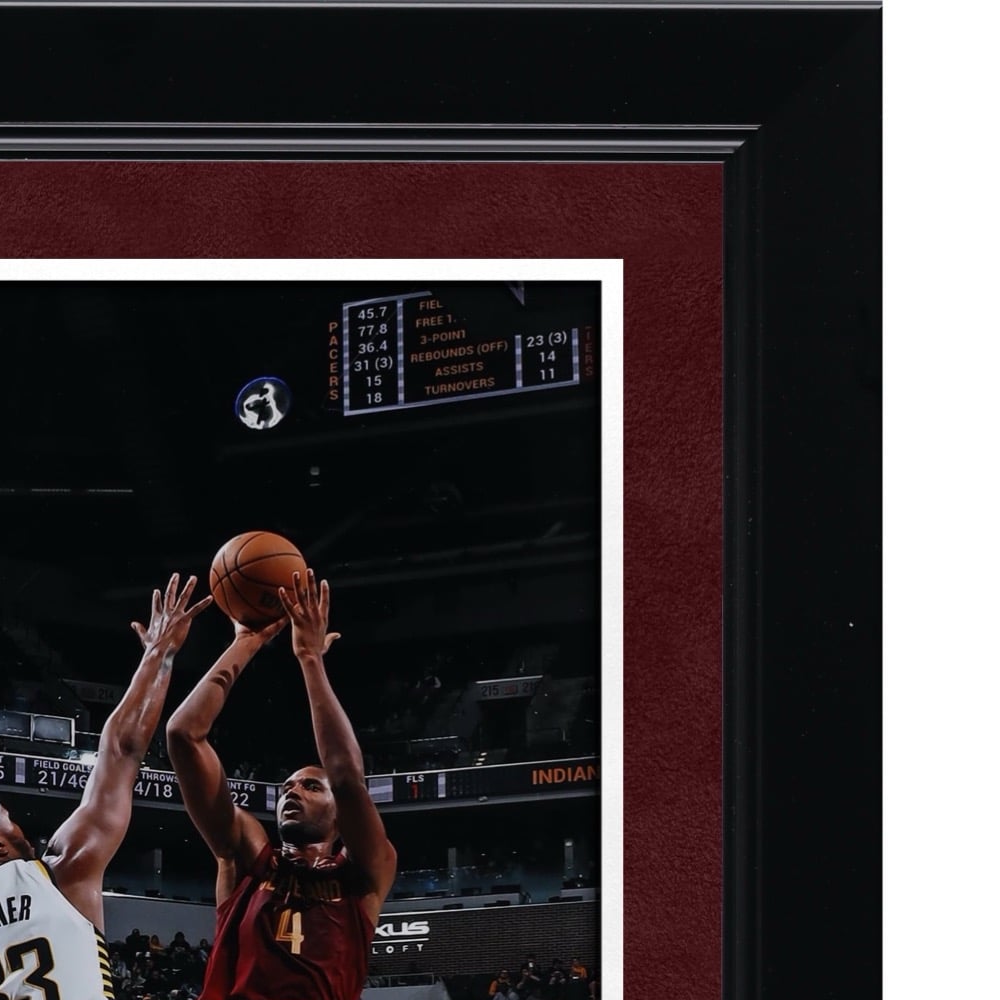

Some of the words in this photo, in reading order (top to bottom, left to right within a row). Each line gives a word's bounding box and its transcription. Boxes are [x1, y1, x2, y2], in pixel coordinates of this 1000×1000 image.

[357, 306, 388, 320] 45.7
[416, 315, 444, 328] FREE
[357, 323, 388, 337] 77.8
[526, 335, 544, 348] 23
[548, 330, 567, 346] (3)
[358, 341, 388, 355] 36.4
[410, 345, 474, 363] REBOUNDS
[477, 340, 509, 355] (OFF)
[328, 322, 339, 401] PACERS
[539, 350, 556, 363] 14
[354, 360, 370, 372] 31
[375, 356, 393, 371] (3)
[435, 361, 484, 377] ASSISTS
[539, 367, 555, 380] 11
[366, 376, 382, 388] 15
[425, 377, 495, 396] TURNOVERS
[366, 393, 382, 405] 18
[33, 759, 62, 771] FIELD
[38, 770, 89, 789] 21/46
[406, 774, 424, 784] FLS
[275, 908, 304, 955] 4
[372, 943, 424, 955] LOFT
